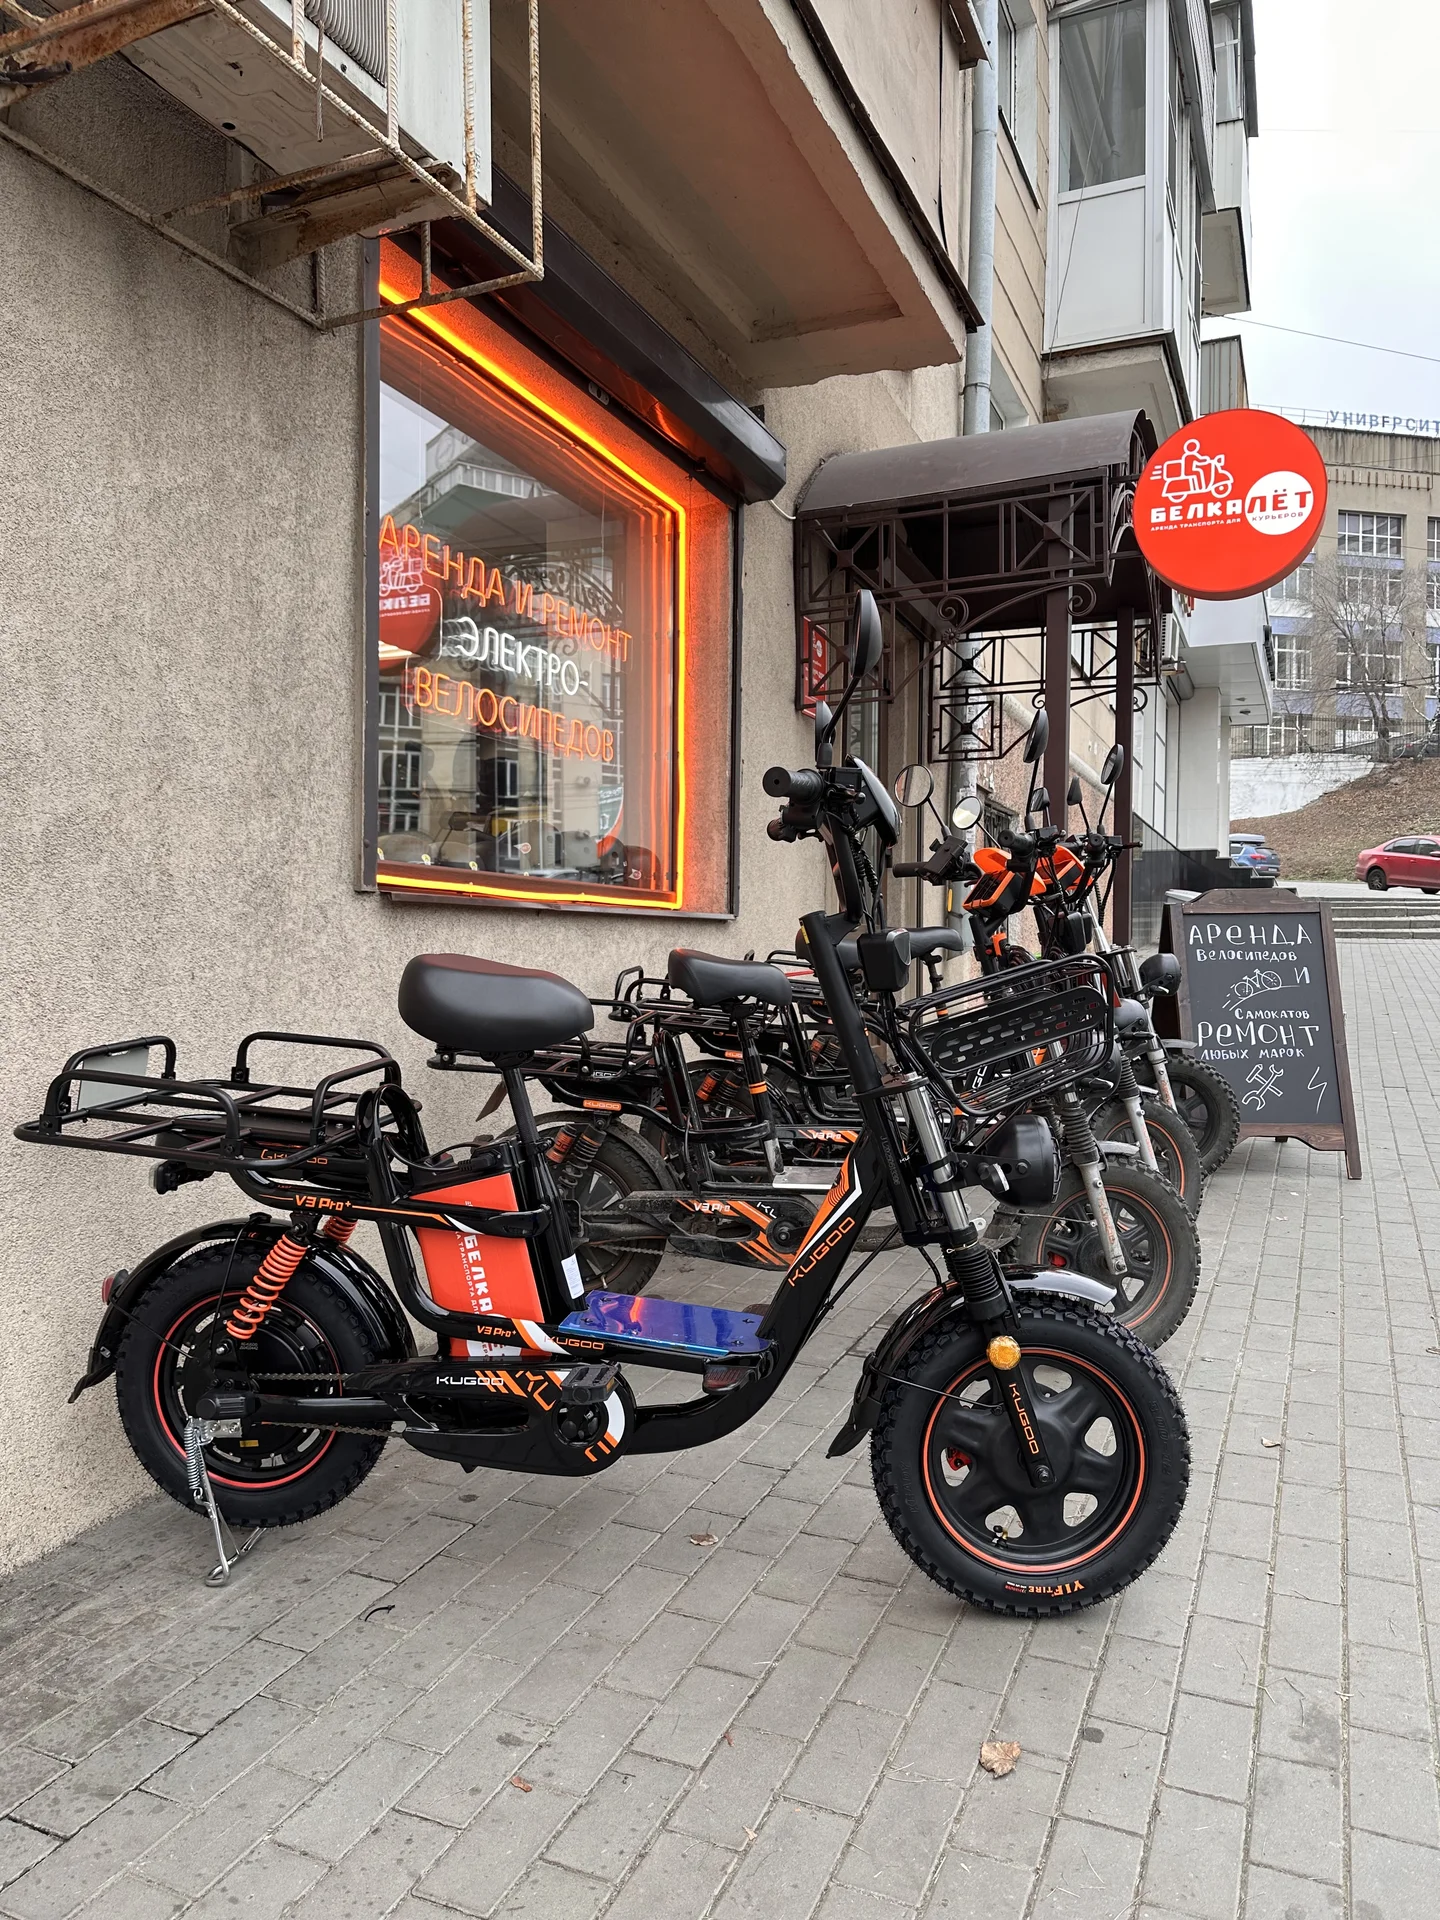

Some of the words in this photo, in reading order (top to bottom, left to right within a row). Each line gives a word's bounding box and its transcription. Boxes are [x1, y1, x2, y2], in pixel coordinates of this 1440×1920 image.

[1151, 499, 1242, 523] БЕЛКА
[1247, 488, 1311, 514] ЛЁТ
[1252, 511, 1304, 522] КУРЬЕРОВ
[1150, 524, 1178, 532] АРЕНДА
[1180, 519, 1224, 529] ТРАНСПОРТА
[379, 514, 505, 607] АРЕНДА
[515, 579, 533, 618] И
[541, 592, 632, 662] РЕМОНТ
[456, 616, 588, 695] ЭЛЕКТРО-
[414, 666, 614, 762] ВЕЛОСИПЕДОВ
[585, 1100, 620, 1110] KUGOO
[295, 1194, 317, 1208] V3
[694, 1202, 710, 1212] V3
[711, 1202, 731, 1213] Pro
[788, 1216, 856, 1287] KUGOO
[463, 1234, 493, 1312] БЕЛКА
[477, 1325, 493, 1336] V3
[544, 1335, 605, 1350] KUGOO
[436, 1376, 504, 1386] KUGOO
[1008, 1383, 1040, 1454] KUGOO
